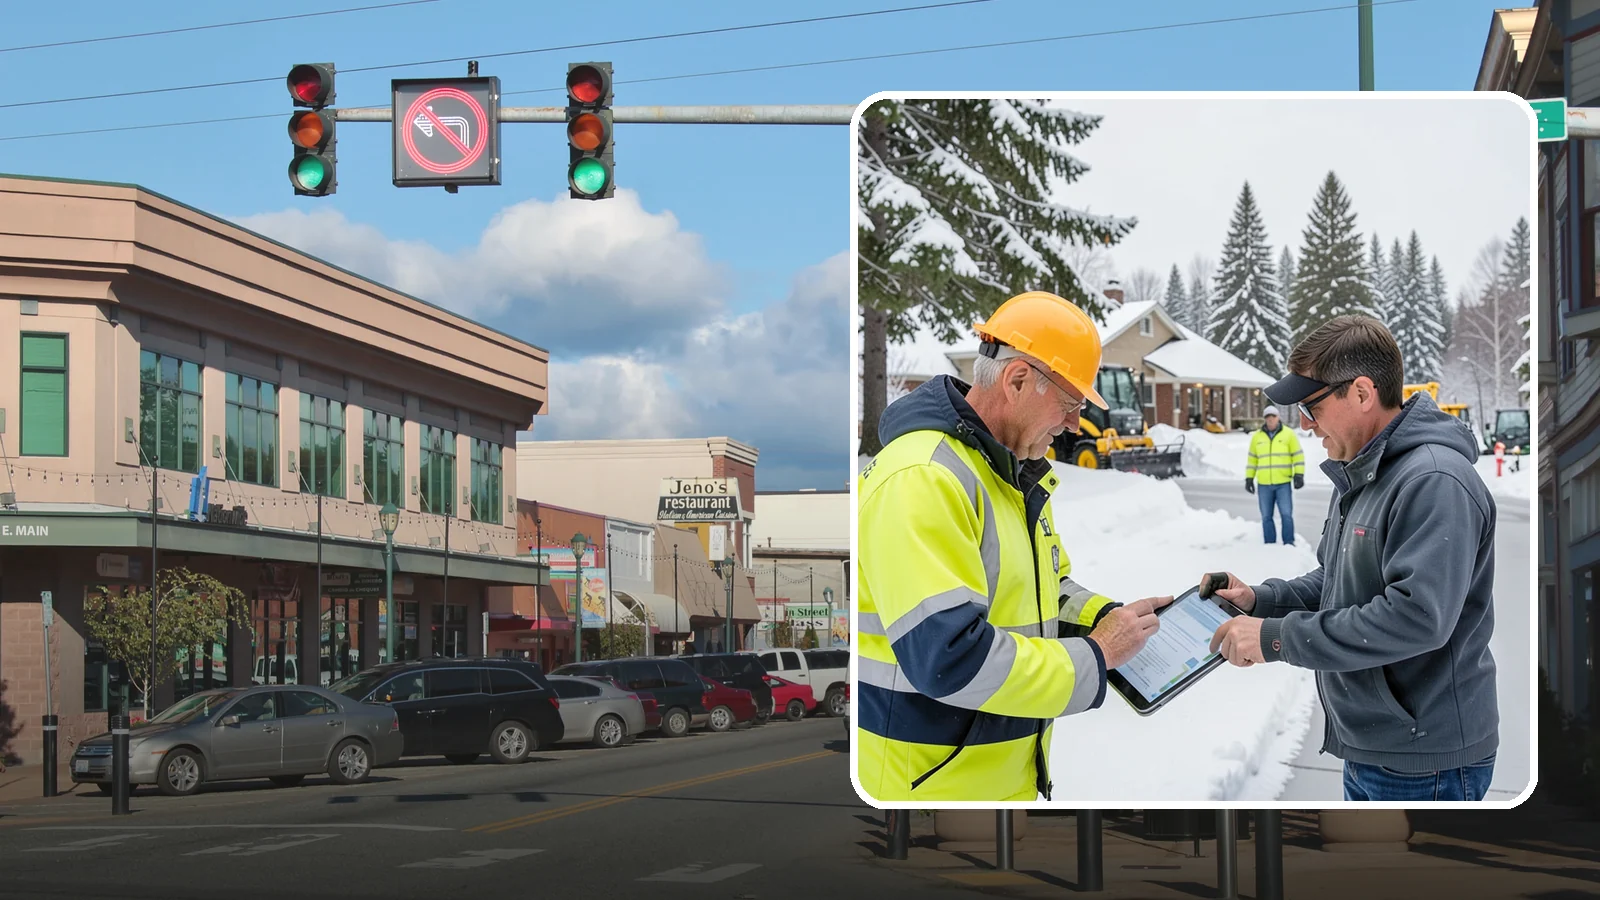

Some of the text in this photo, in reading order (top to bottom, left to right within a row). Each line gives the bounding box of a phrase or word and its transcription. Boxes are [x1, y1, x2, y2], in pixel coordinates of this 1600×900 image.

[670, 480, 727, 494] Jeno's
[665, 496, 731, 509] restaurant
[658, 510, 682, 519] Italian
[686, 509, 715, 519] American
[715, 509, 737, 519] Cuisine
[2, 525, 49, 536] E. MAIN
[797, 607, 828, 617] Street
[791, 619, 824, 627] lass
